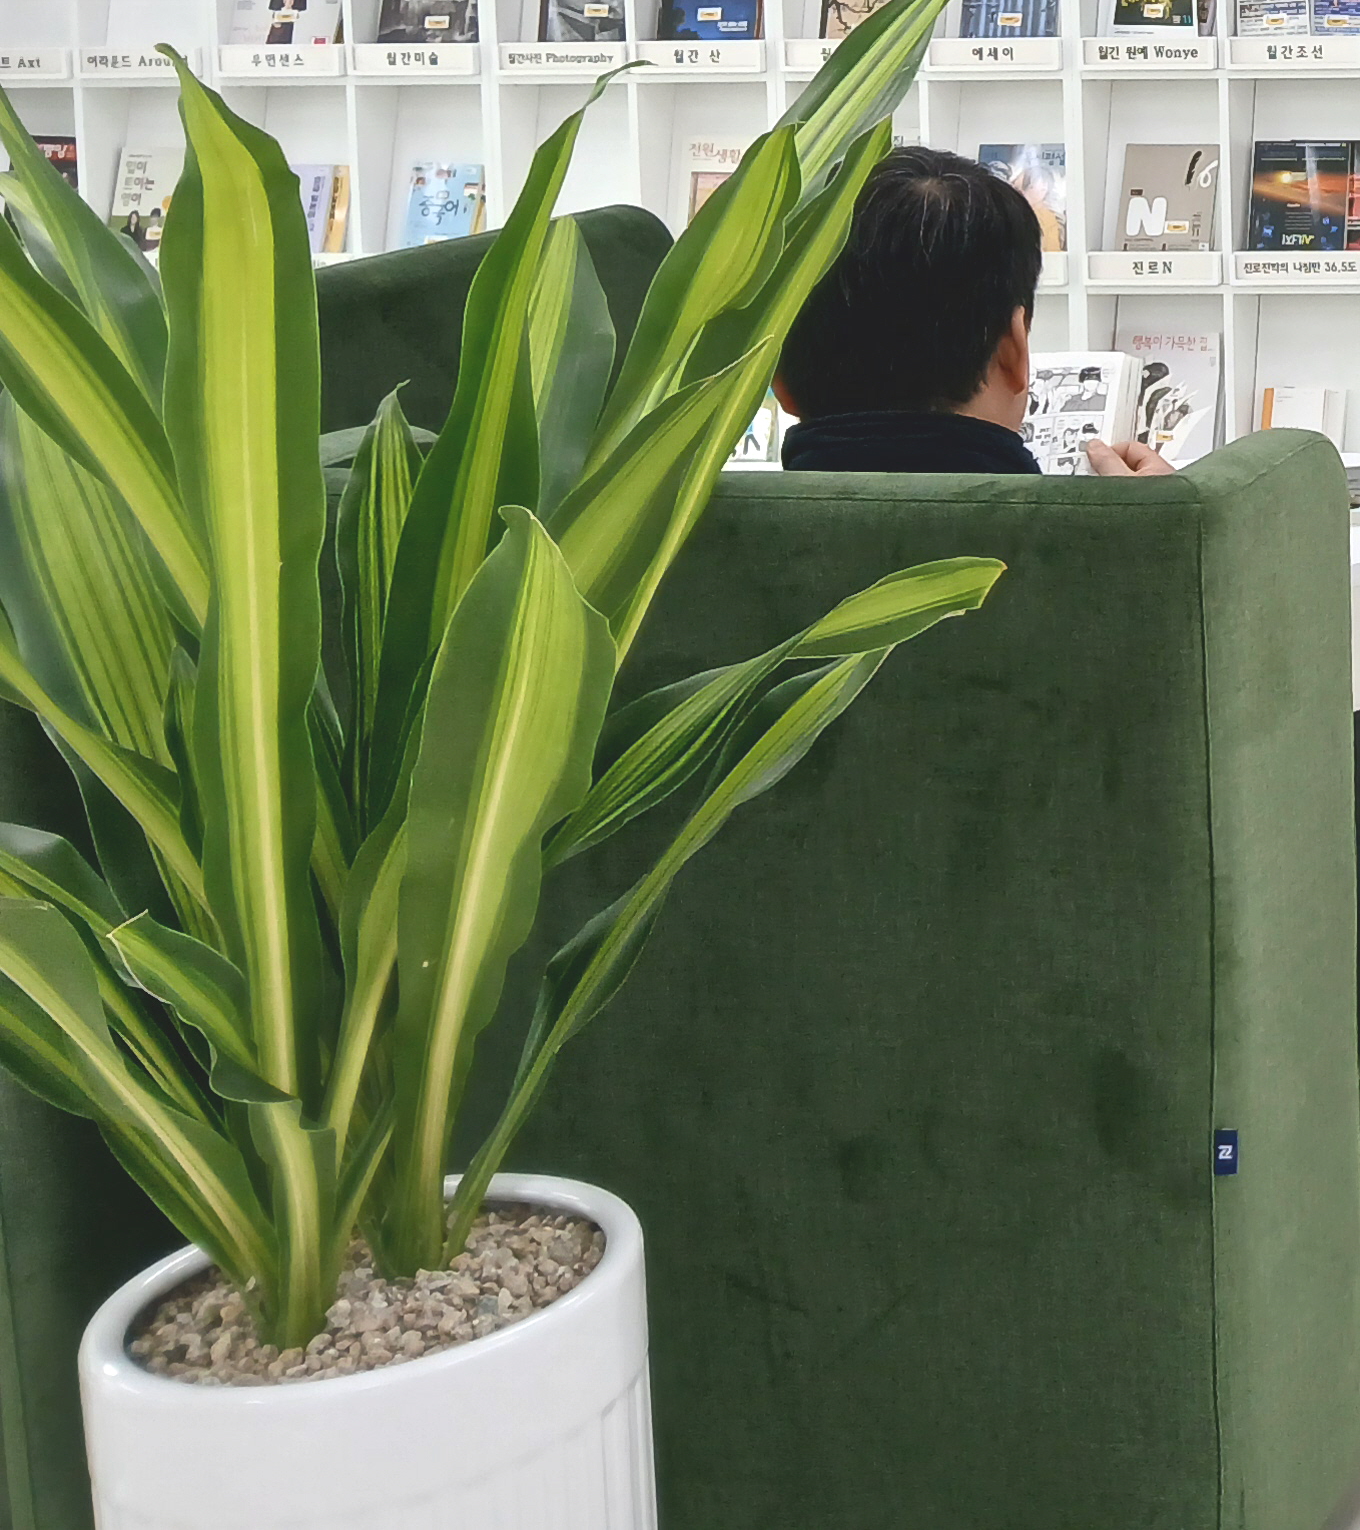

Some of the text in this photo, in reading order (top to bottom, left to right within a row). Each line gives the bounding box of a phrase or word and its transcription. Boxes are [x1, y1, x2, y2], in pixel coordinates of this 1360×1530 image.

[545, 52, 614, 65] Photography
[709, 49, 721, 64] 산
[972, 46, 1014, 61] 에세이
[1153, 46, 1199, 59] Wonye
